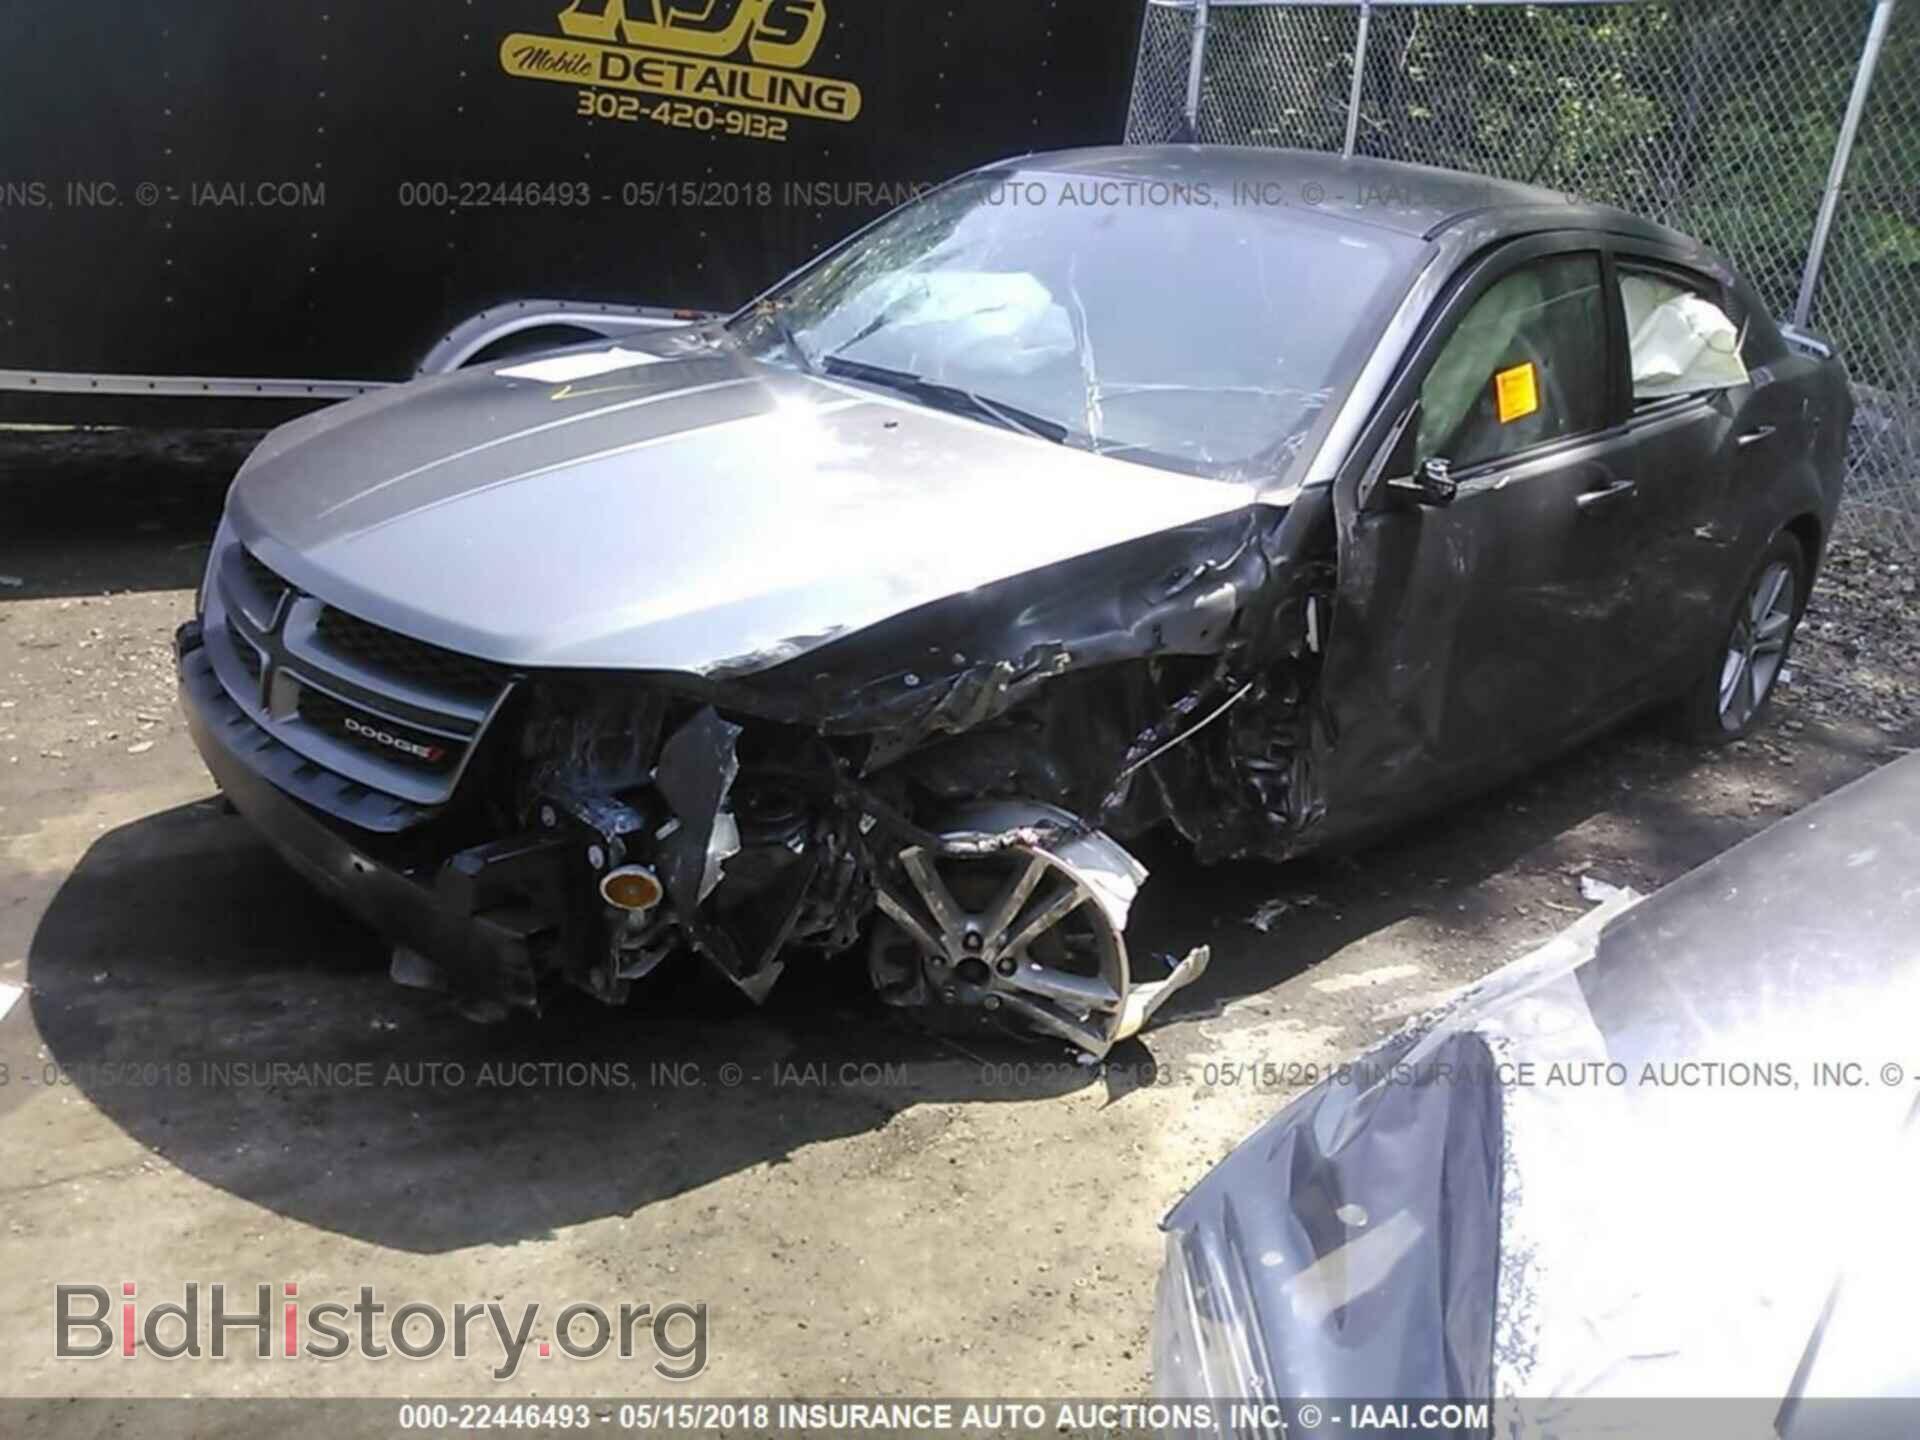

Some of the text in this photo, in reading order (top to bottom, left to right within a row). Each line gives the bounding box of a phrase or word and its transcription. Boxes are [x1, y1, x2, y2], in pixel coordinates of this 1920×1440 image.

[512, 46, 848, 114] Mobile DETAILING
[576, 90, 788, 141] 302-420-9132
[344, 718, 432, 759] DODGE
